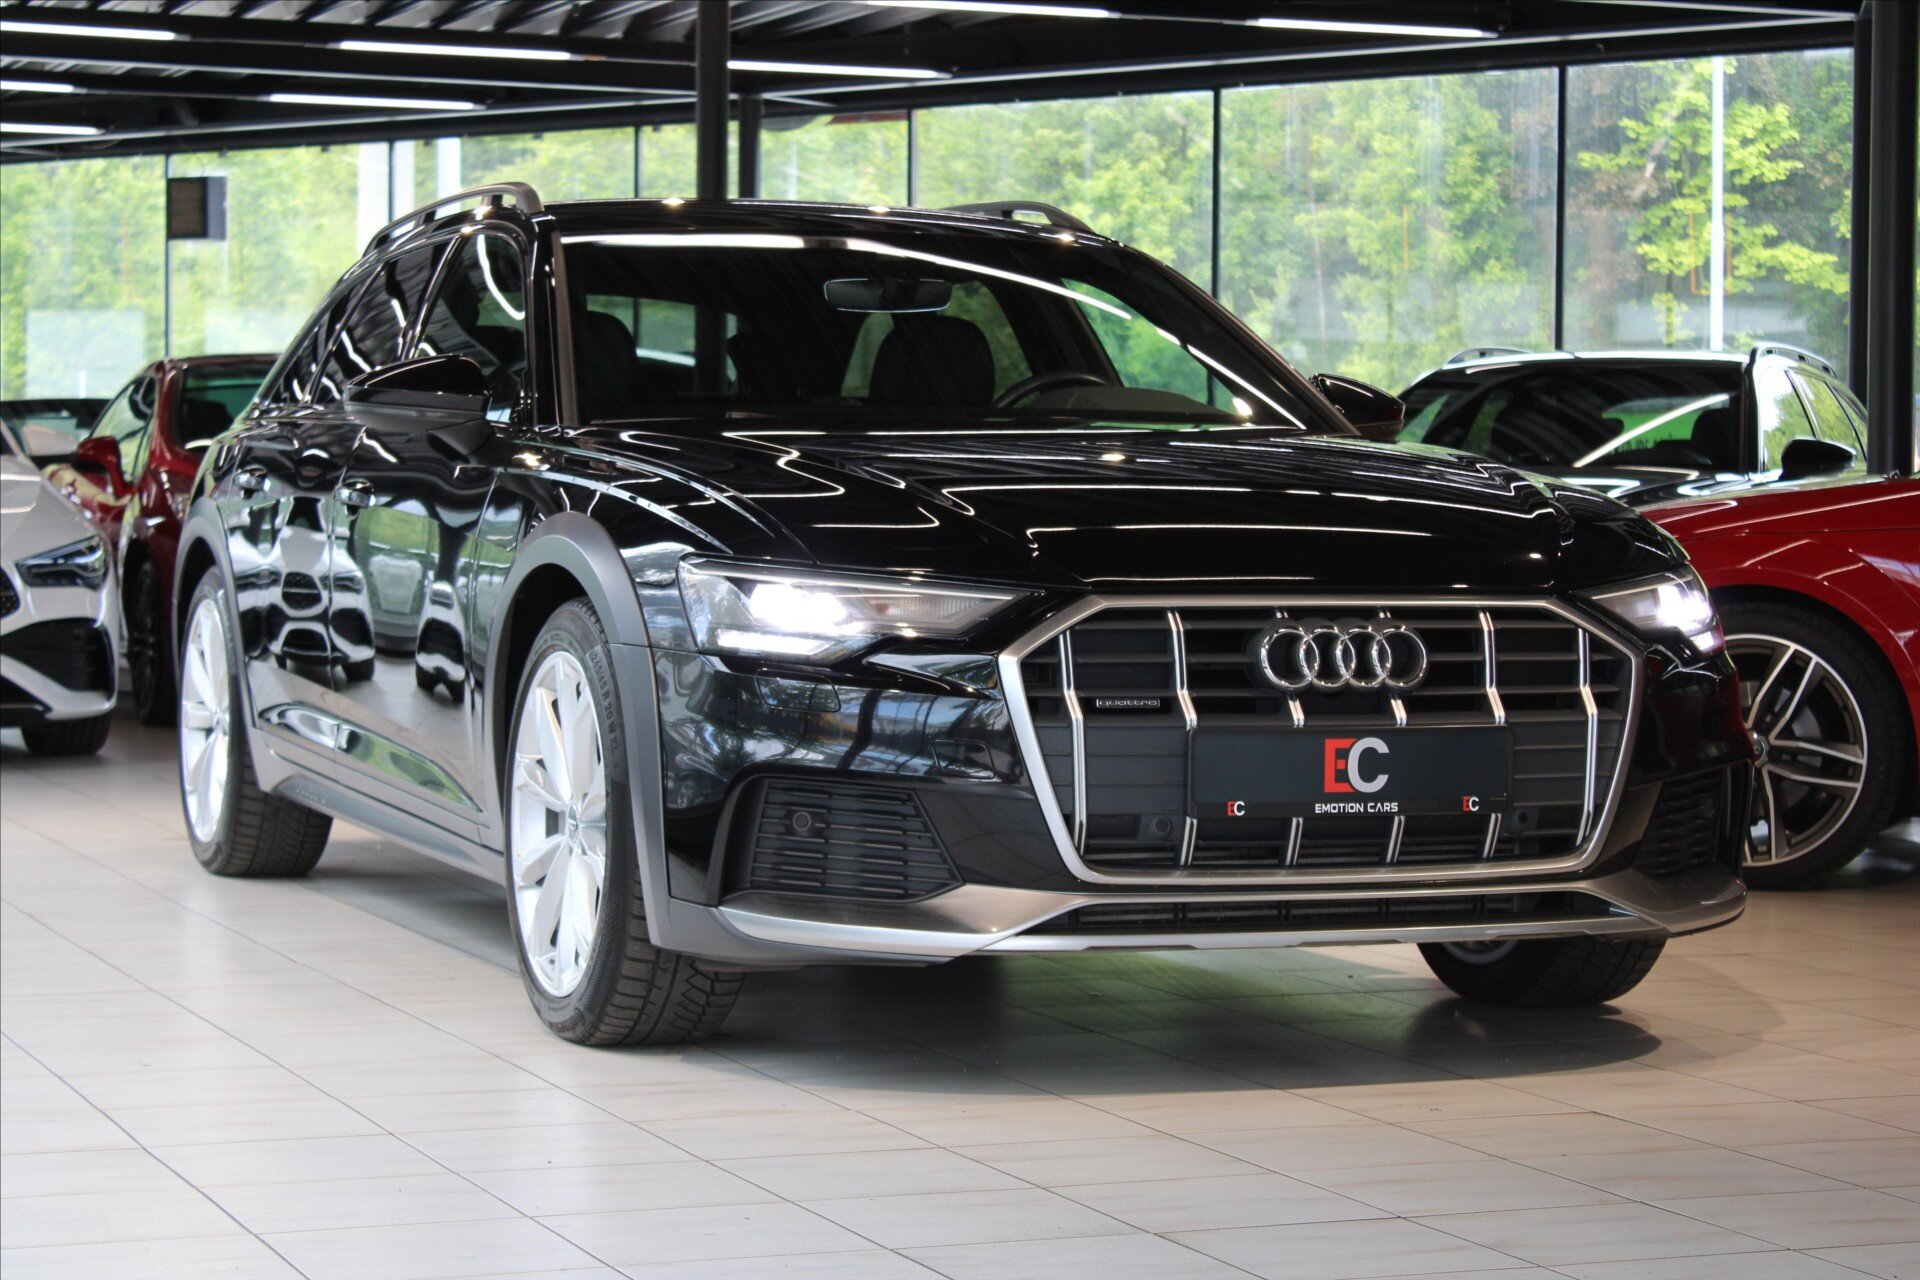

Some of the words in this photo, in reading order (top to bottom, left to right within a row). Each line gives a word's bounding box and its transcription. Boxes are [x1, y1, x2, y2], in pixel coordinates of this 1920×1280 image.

[604, 702, 614, 719] 20
[1099, 699, 1158, 707] quattro
[1323, 737, 1390, 793] EC
[1227, 800, 1246, 817] EC
[1315, 803, 1364, 814] EMOTION
[1367, 802, 1399, 813] CARS
[1462, 795, 1480, 812] EC
